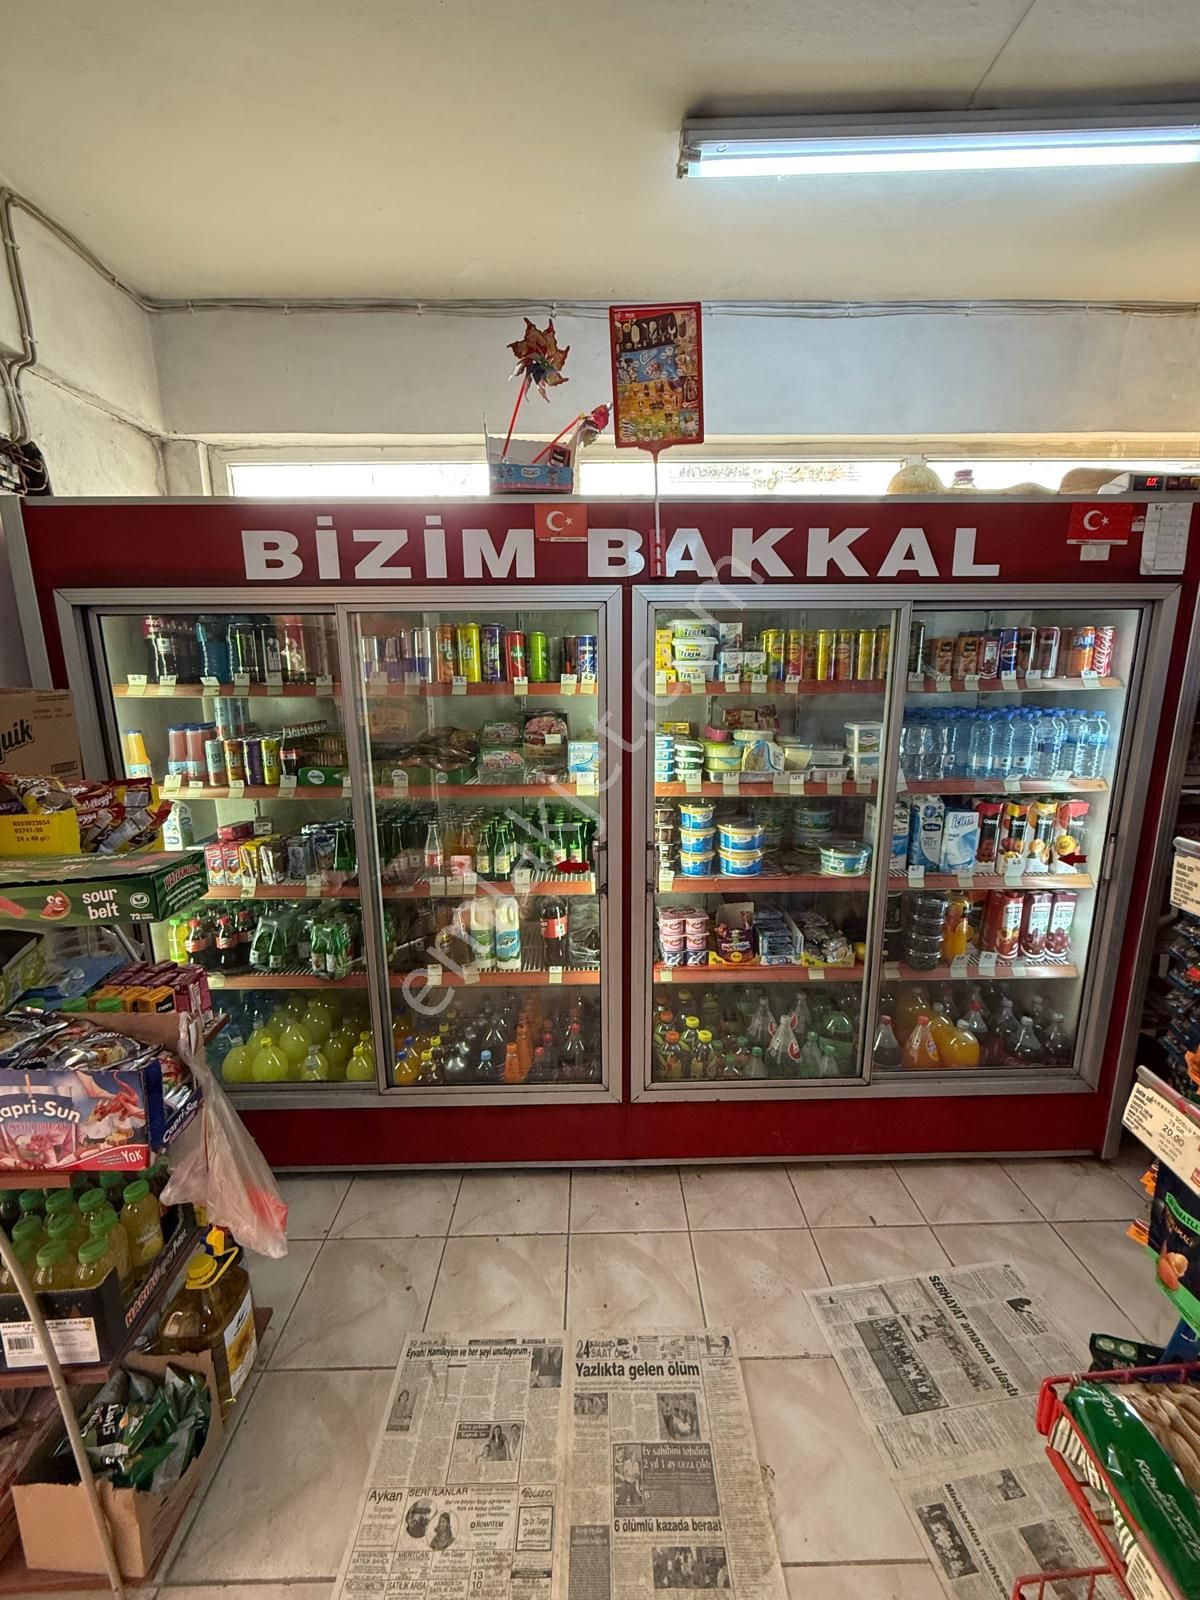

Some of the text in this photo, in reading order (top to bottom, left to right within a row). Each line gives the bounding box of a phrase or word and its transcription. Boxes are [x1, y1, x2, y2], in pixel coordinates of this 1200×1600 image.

[241, 515, 1000, 582] BİZİM BAKKAL
[684, 628, 706, 636] TEREM
[680, 651, 701, 659] TEREM
[0, 718, 34, 755] uik
[82, 888, 118, 904] sour
[88, 902, 119, 920] belt
[130, 912, 142, 920] 72
[0, 1099, 81, 1123] apri-Sun
[1162, 1124, 1185, 1147] 20.00
[929, 1274, 969, 1327] SERHAYAT
[960, 1321, 996, 1366] amacına
[468, 1347, 479, 1356] her
[576, 1339, 590, 1359] 24
[575, 1362, 625, 1377] Yazlıkta
[629, 1364, 664, 1380] gelen
[668, 1360, 700, 1376] ölüm
[643, 1445, 651, 1455] Ev
[653, 1444, 681, 1455] sahibini
[643, 1459, 649, 1469] 2
[667, 1461, 676, 1471] ay
[678, 1461, 695, 1470] ceza
[368, 1490, 403, 1506] Aykan
[432, 1487, 469, 1497] İLANLAR
[614, 1518, 723, 1532] 6 ölümlü kazada beraat
[473, 1571, 483, 1580] 13
[472, 1581, 483, 1590] 10
